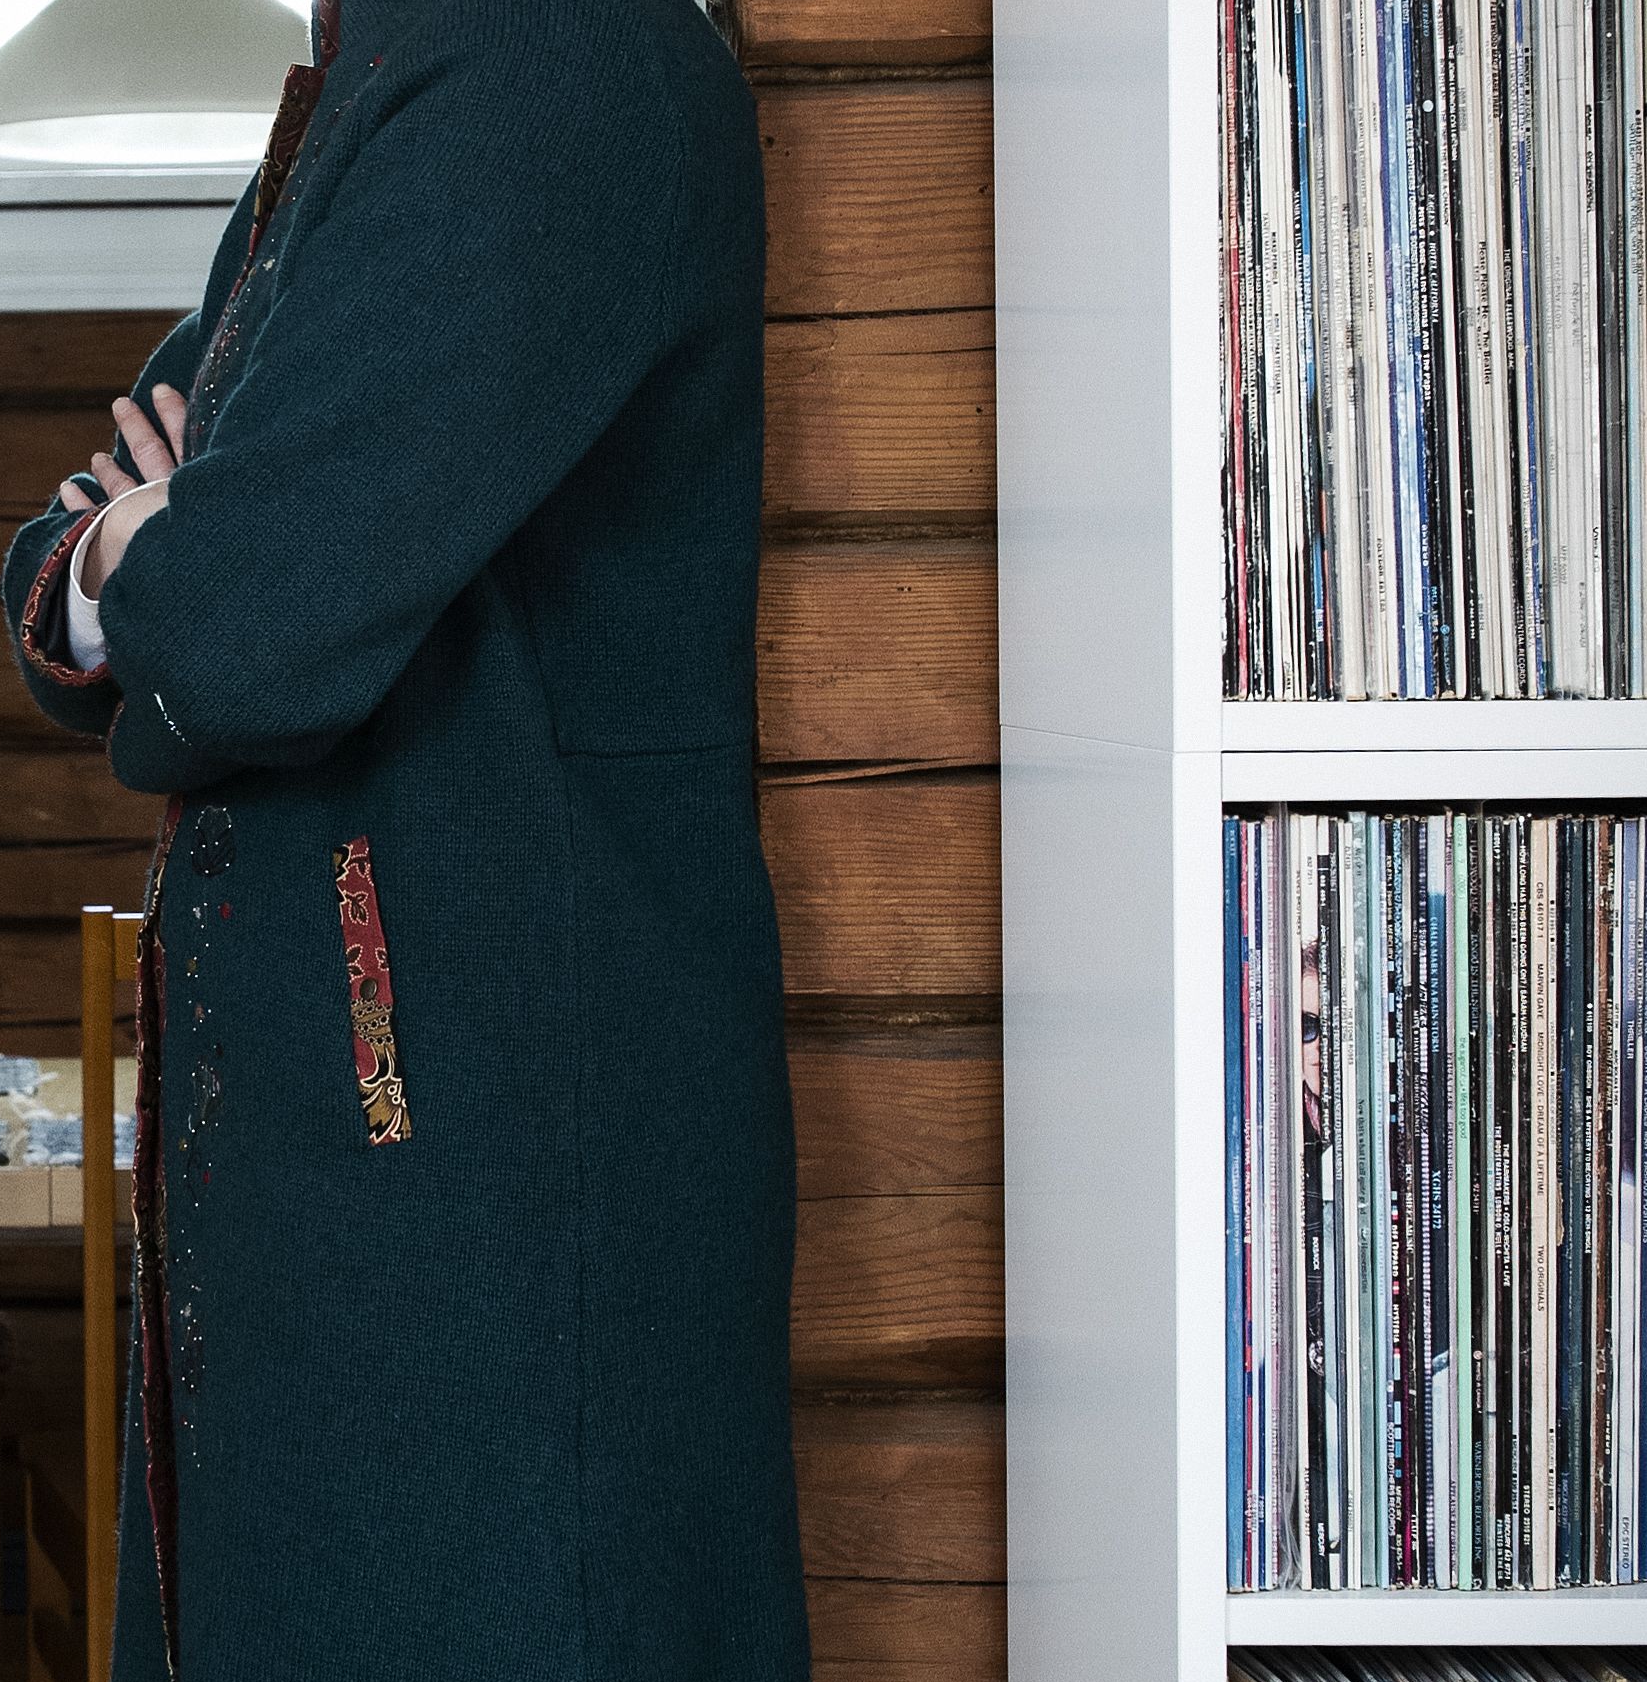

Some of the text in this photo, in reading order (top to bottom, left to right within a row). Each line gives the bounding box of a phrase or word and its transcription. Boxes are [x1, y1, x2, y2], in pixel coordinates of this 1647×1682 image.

[1448, 45, 1456, 58] THE
[1405, 104, 1413, 120] THE
[1449, 82, 1457, 114] LENNON
[1405, 123, 1414, 148] BLUES
[1406, 151, 1416, 192] BROTHERS
[1428, 194, 1439, 323] EAGLES HOTEL CALIFORNIA
[1479, 241, 1491, 386] Please Please Me The Beatles
[1536, 882, 1544, 899] CBS
[1536, 902, 1544, 933] 461017
[1519, 845, 1527, 1052] HOW LONG HAS THIS BEEN GOING ON? SARAH VAUGHAN
[1627, 924, 1635, 959] MICHAEL
[1536, 963, 1544, 995] MARVIN
[1627, 962, 1635, 1001] JACKSON
[1536, 997, 1544, 1020] GAYE
[1536, 1032, 1544, 1072] MIDNIGHT
[1627, 1021, 1635, 1059] THRILLER
[1536, 1075, 1544, 1098] LOVE
[1536, 1105, 1544, 1134] DREAM
[1536, 1137, 1544, 1149] OF
[1536, 1159, 1544, 1197] LIFETIME
[1432, 1169, 1441, 1230] XGHS 24172
[1473, 1440, 1483, 1545] WARNER BROS. RECORDS
[1622, 1517, 1630, 1569] EPIC STEREO
